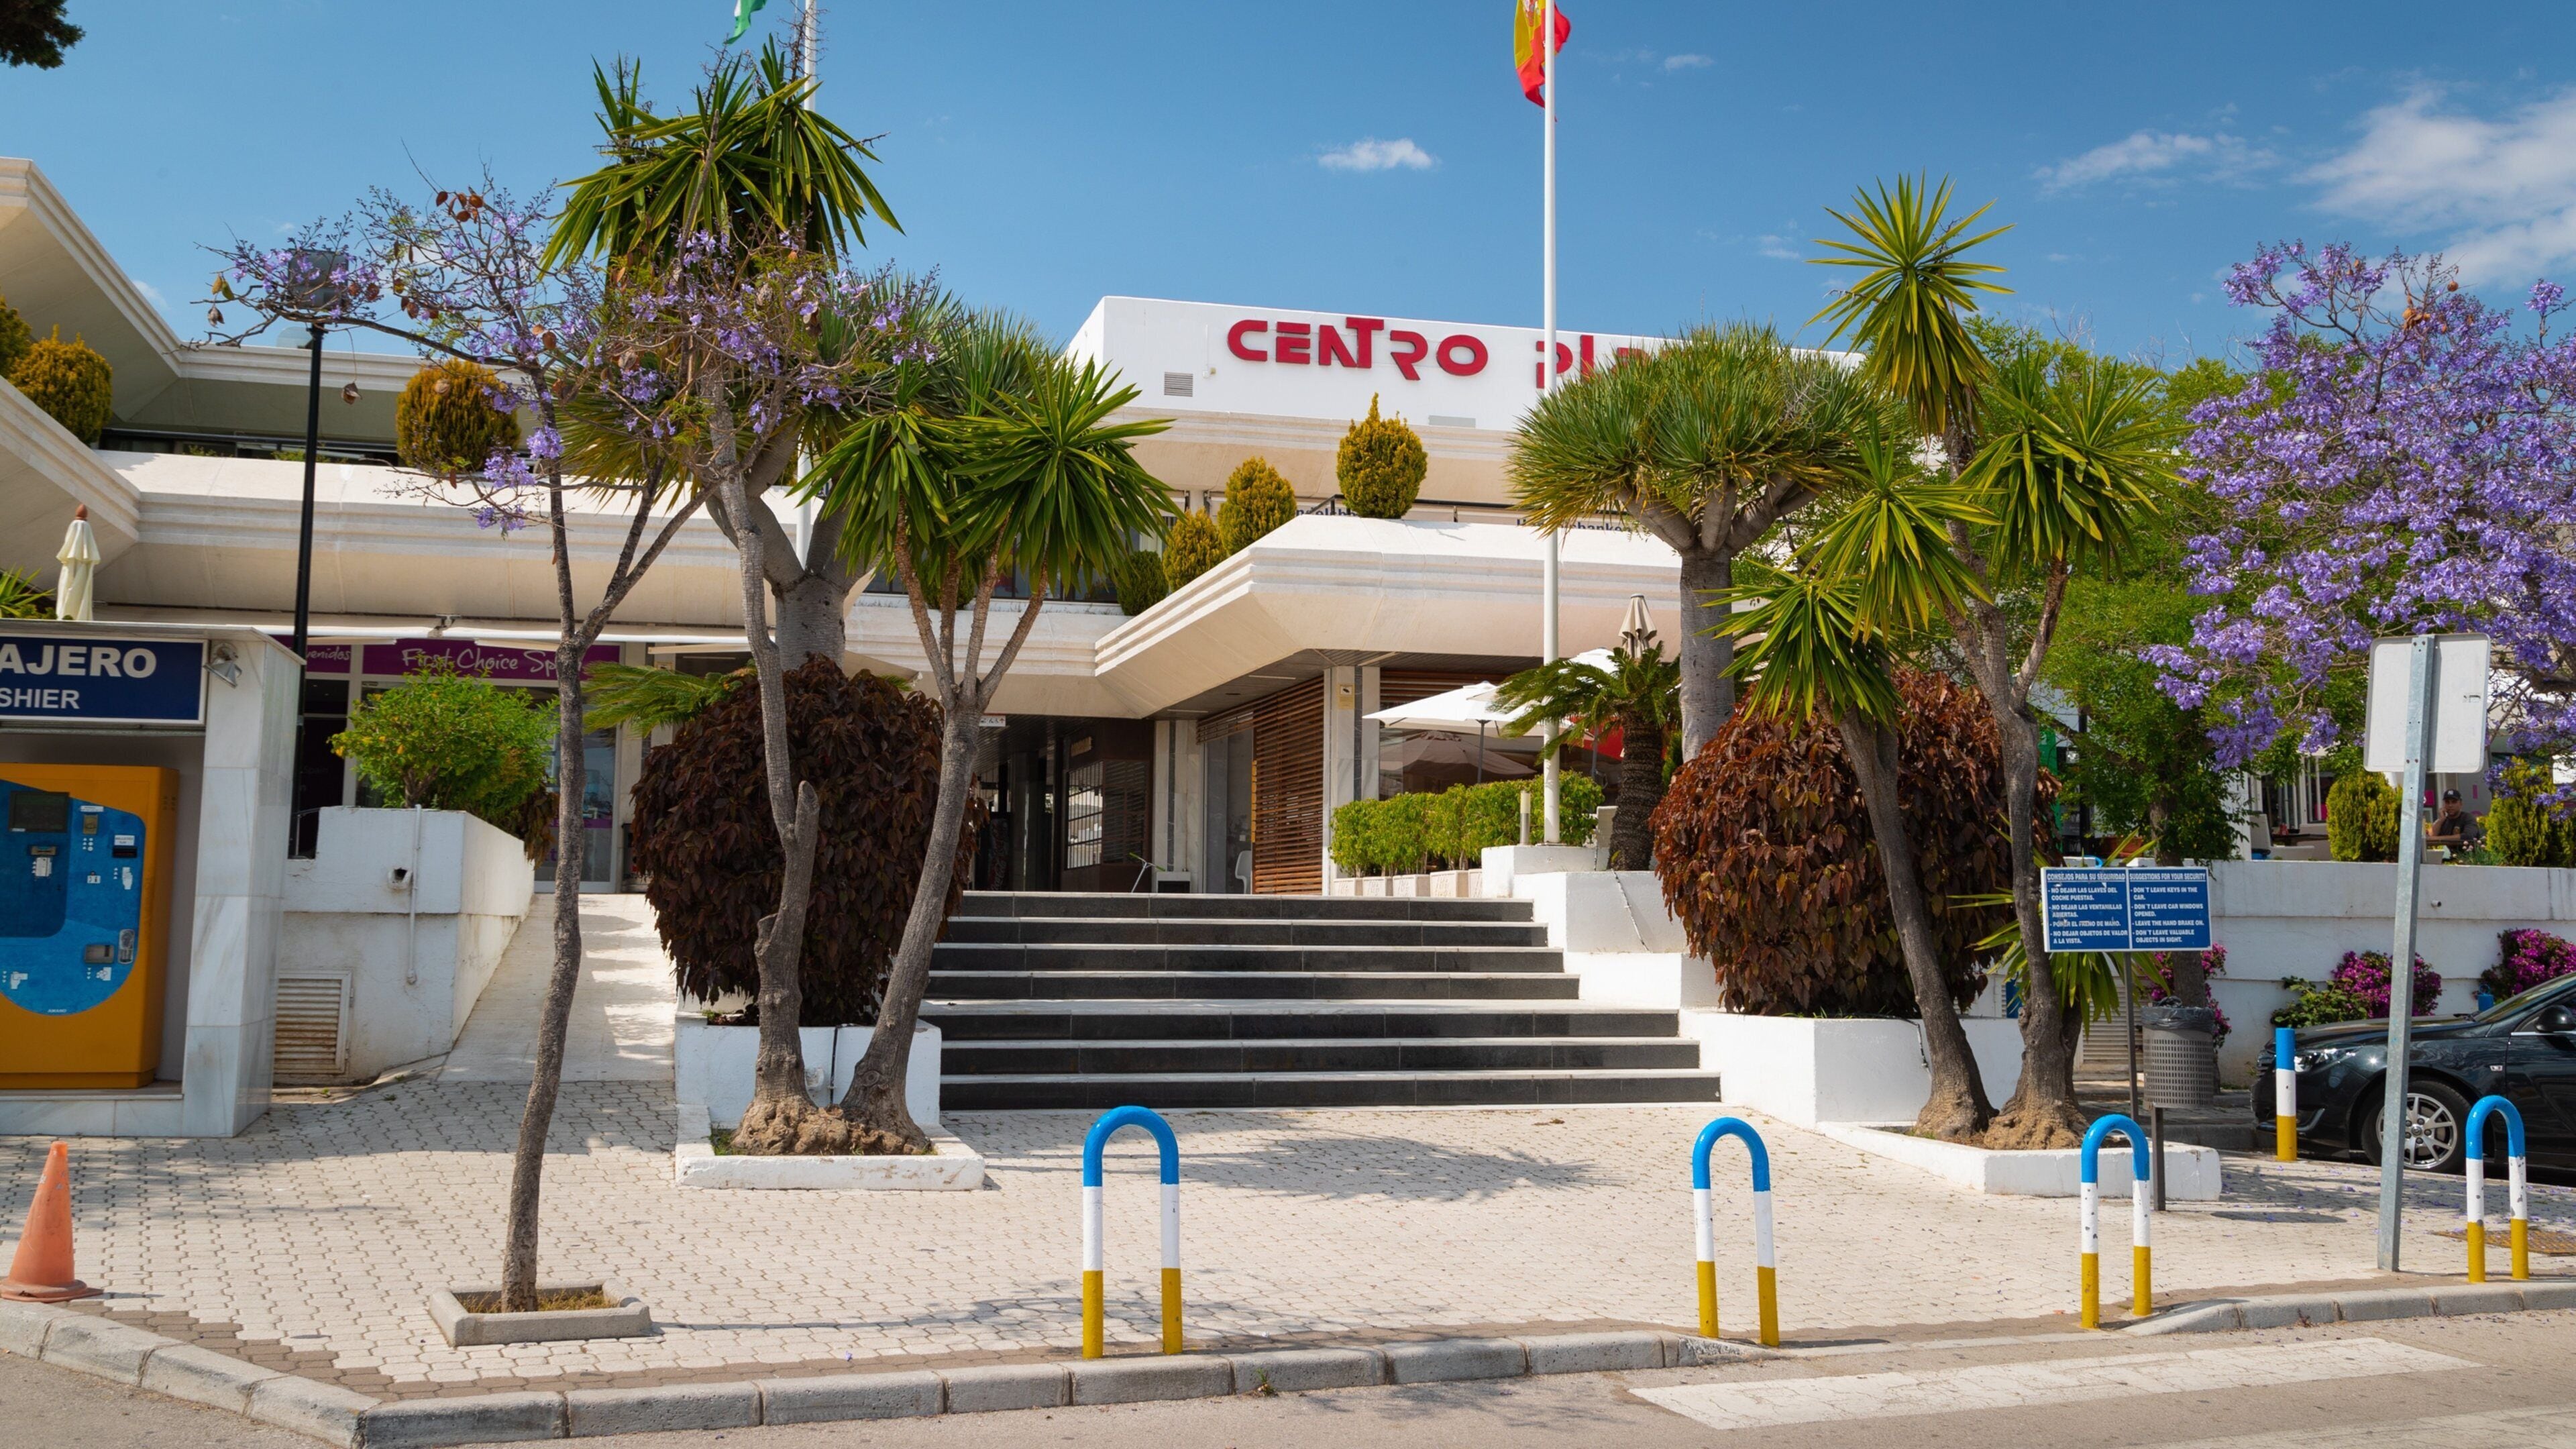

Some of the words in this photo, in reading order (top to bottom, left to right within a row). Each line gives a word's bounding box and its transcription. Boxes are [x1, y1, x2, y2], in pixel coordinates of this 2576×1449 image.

[1227, 317, 1489, 381] CENTRO
[0, 643, 157, 678] AJERO
[402, 648, 452, 668] First
[457, 648, 519, 670] Choice
[0, 687, 80, 709] SHIER
